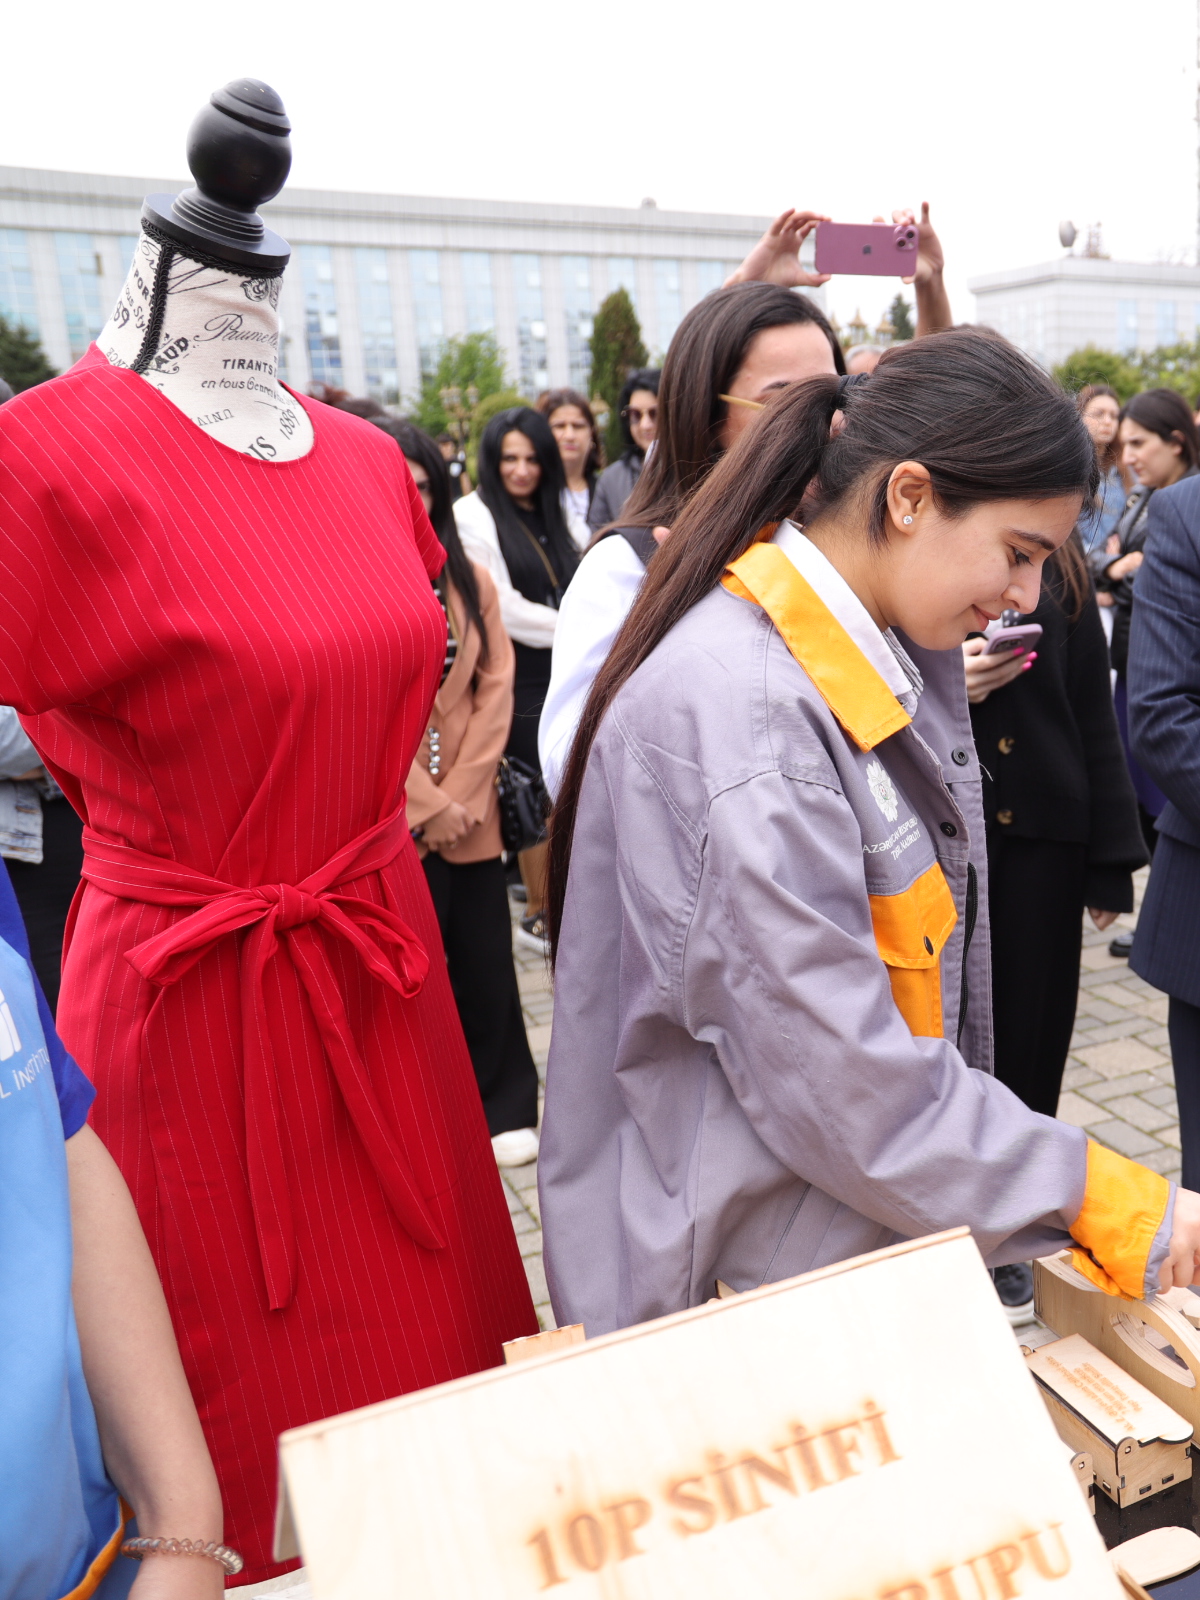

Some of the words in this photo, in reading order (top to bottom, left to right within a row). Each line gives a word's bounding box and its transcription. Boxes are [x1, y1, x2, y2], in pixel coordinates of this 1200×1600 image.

[222, 358, 273, 376] TIRANTS
[201, 380, 216, 389] en
[219, 377, 245, 389] tous
[279, 408, 301, 441] 1889
[526, 1498, 653, 1590] 10P
[664, 1399, 903, 1537] SİNİFİ
